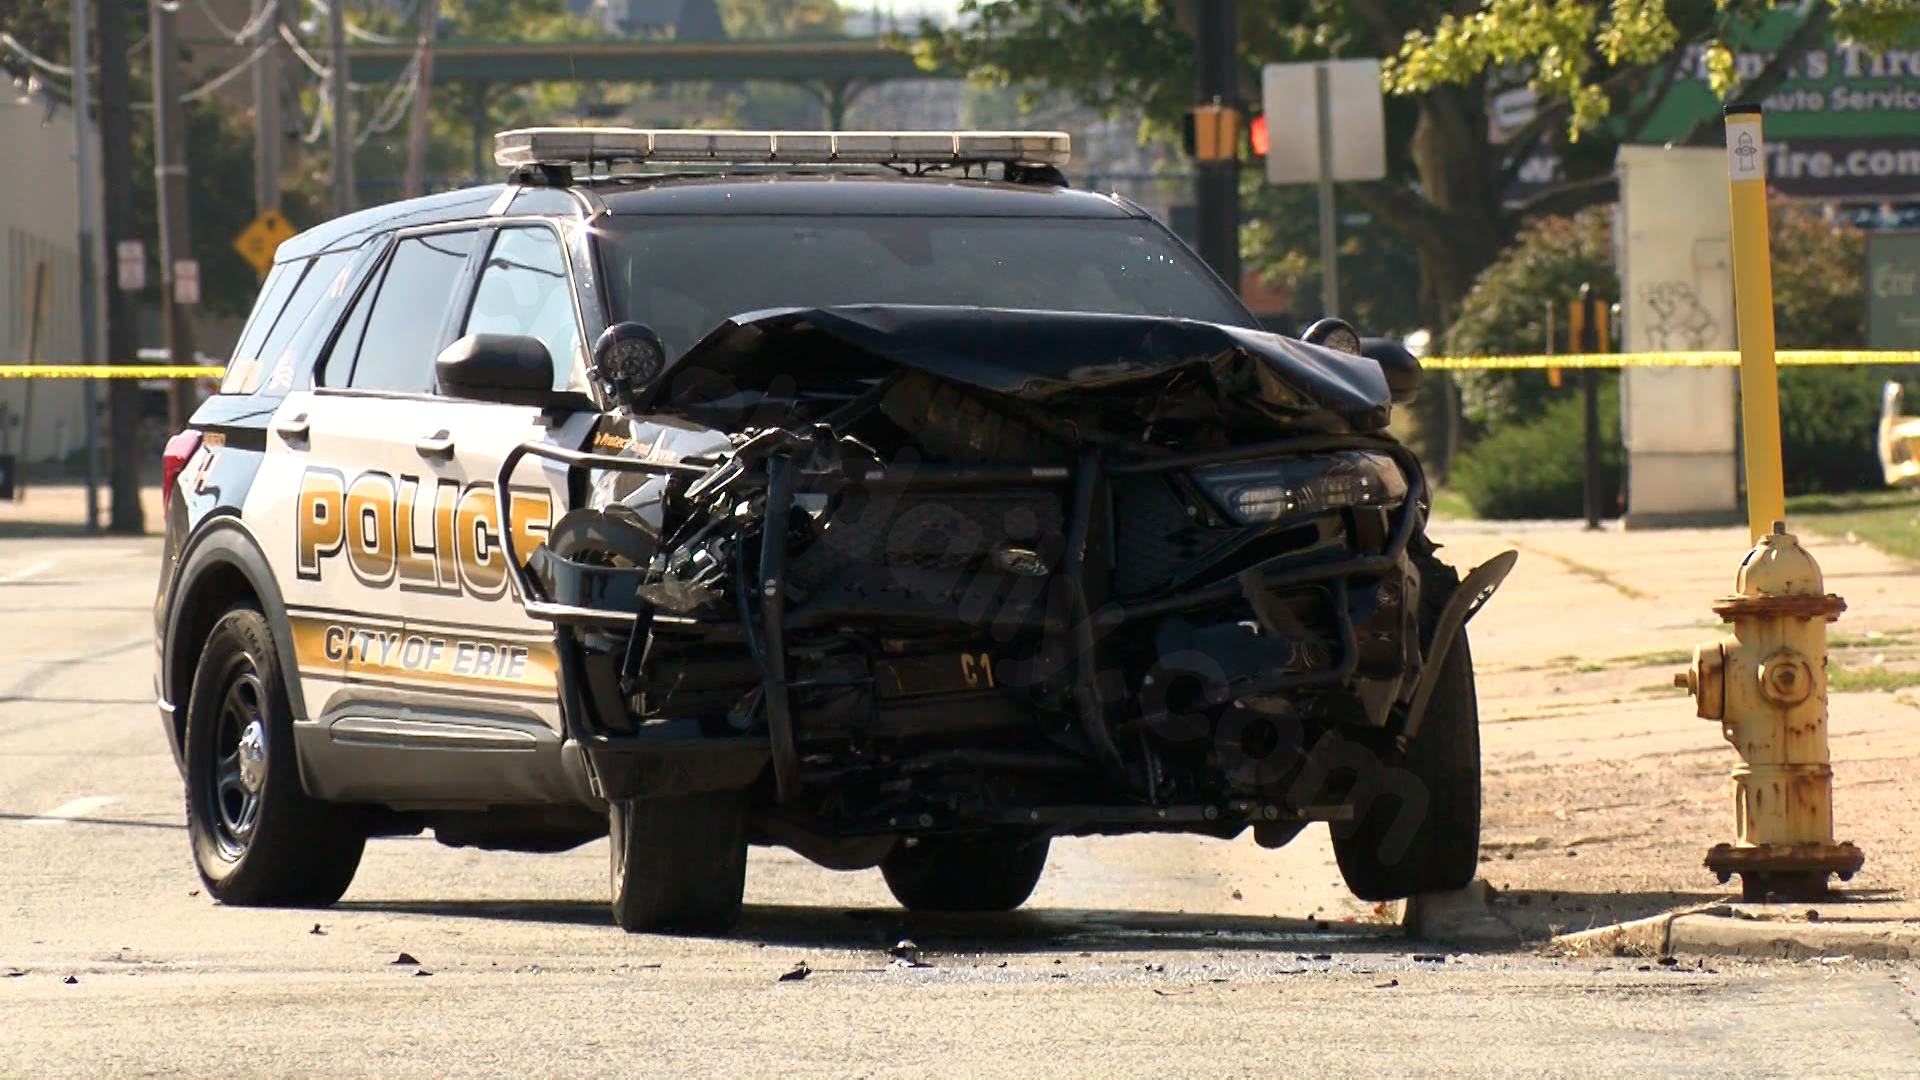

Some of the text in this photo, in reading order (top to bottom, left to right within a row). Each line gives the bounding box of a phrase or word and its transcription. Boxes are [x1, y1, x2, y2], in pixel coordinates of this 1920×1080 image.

[1831, 85, 1920, 112] Servic
[297, 466, 553, 603] POLICE
[323, 624, 529, 679] CITY OF ERIE
[960, 652, 995, 689] C1
